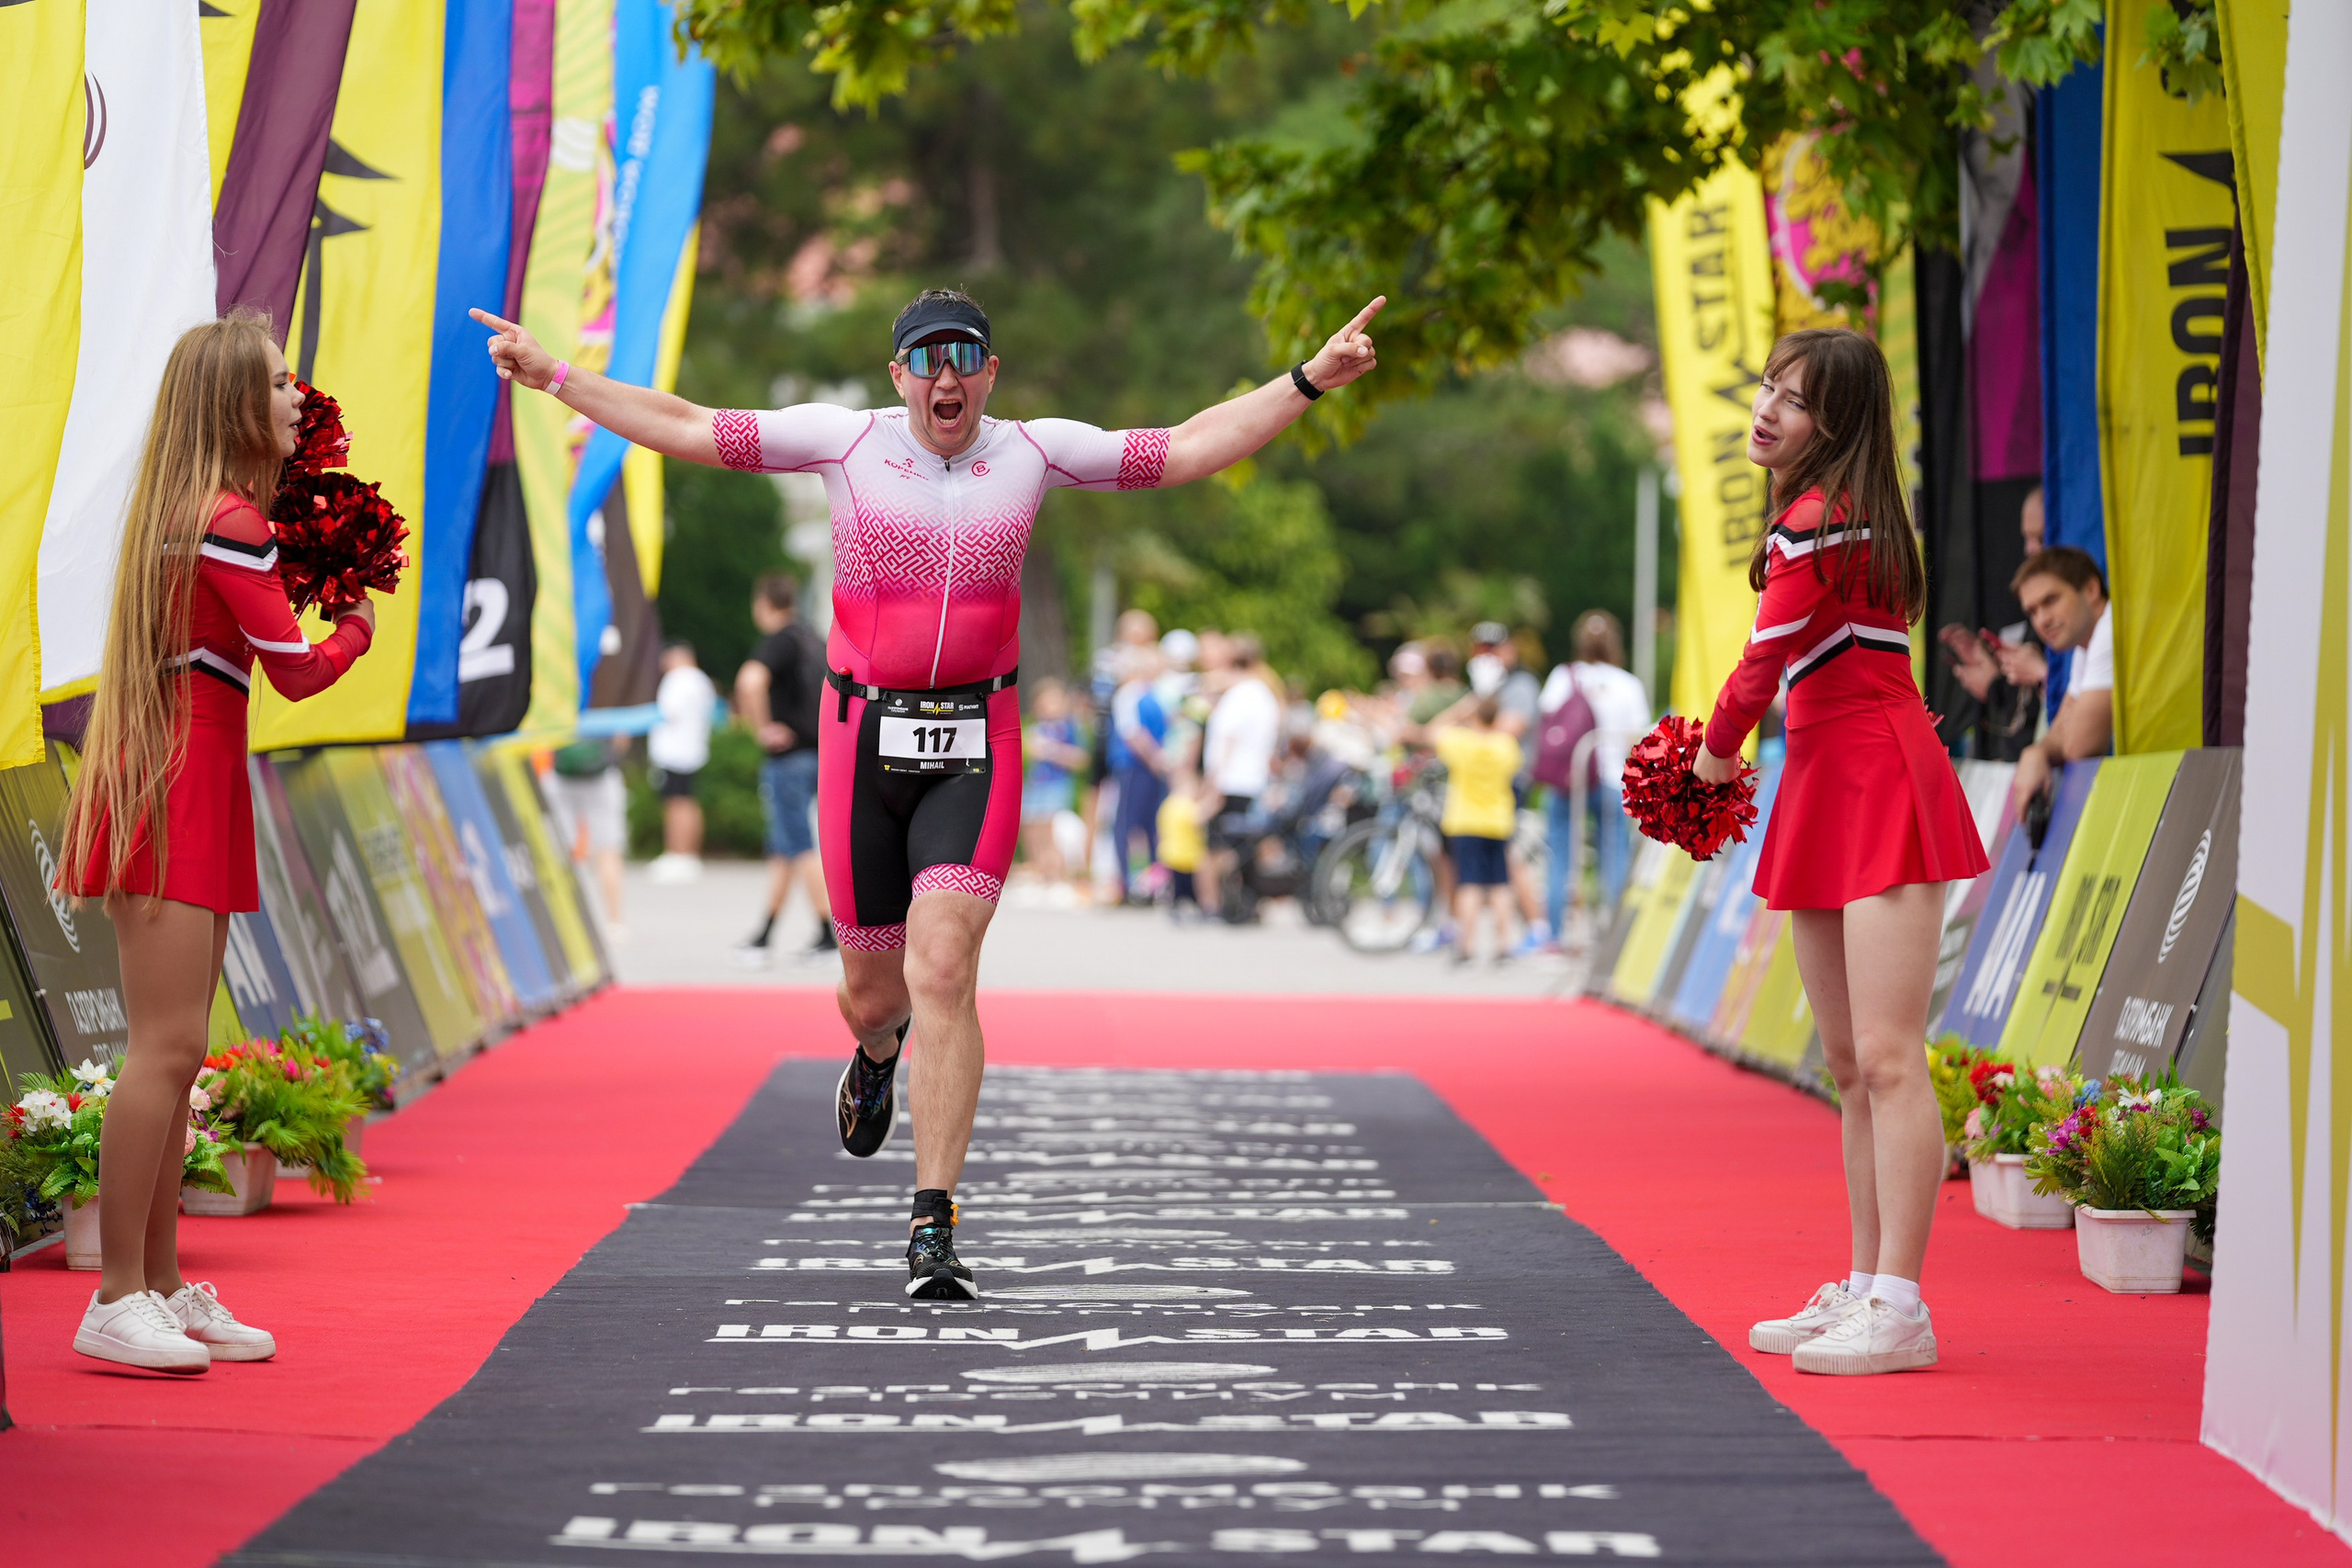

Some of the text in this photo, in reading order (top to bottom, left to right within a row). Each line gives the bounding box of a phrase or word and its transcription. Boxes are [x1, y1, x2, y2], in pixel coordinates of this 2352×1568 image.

[2165, 226, 2234, 457] IRON
[920, 701, 955, 710] IRON STAR
[912, 727, 957, 753] 117
[920, 761, 944, 770] MIHAIL
[1170, 1257, 1456, 1271] STAR
[715, 1325, 1509, 1339] IRON STAR
[654, 1411, 1573, 1427] IRON STAR
[562, 1517, 1662, 1557] IRON STAR
